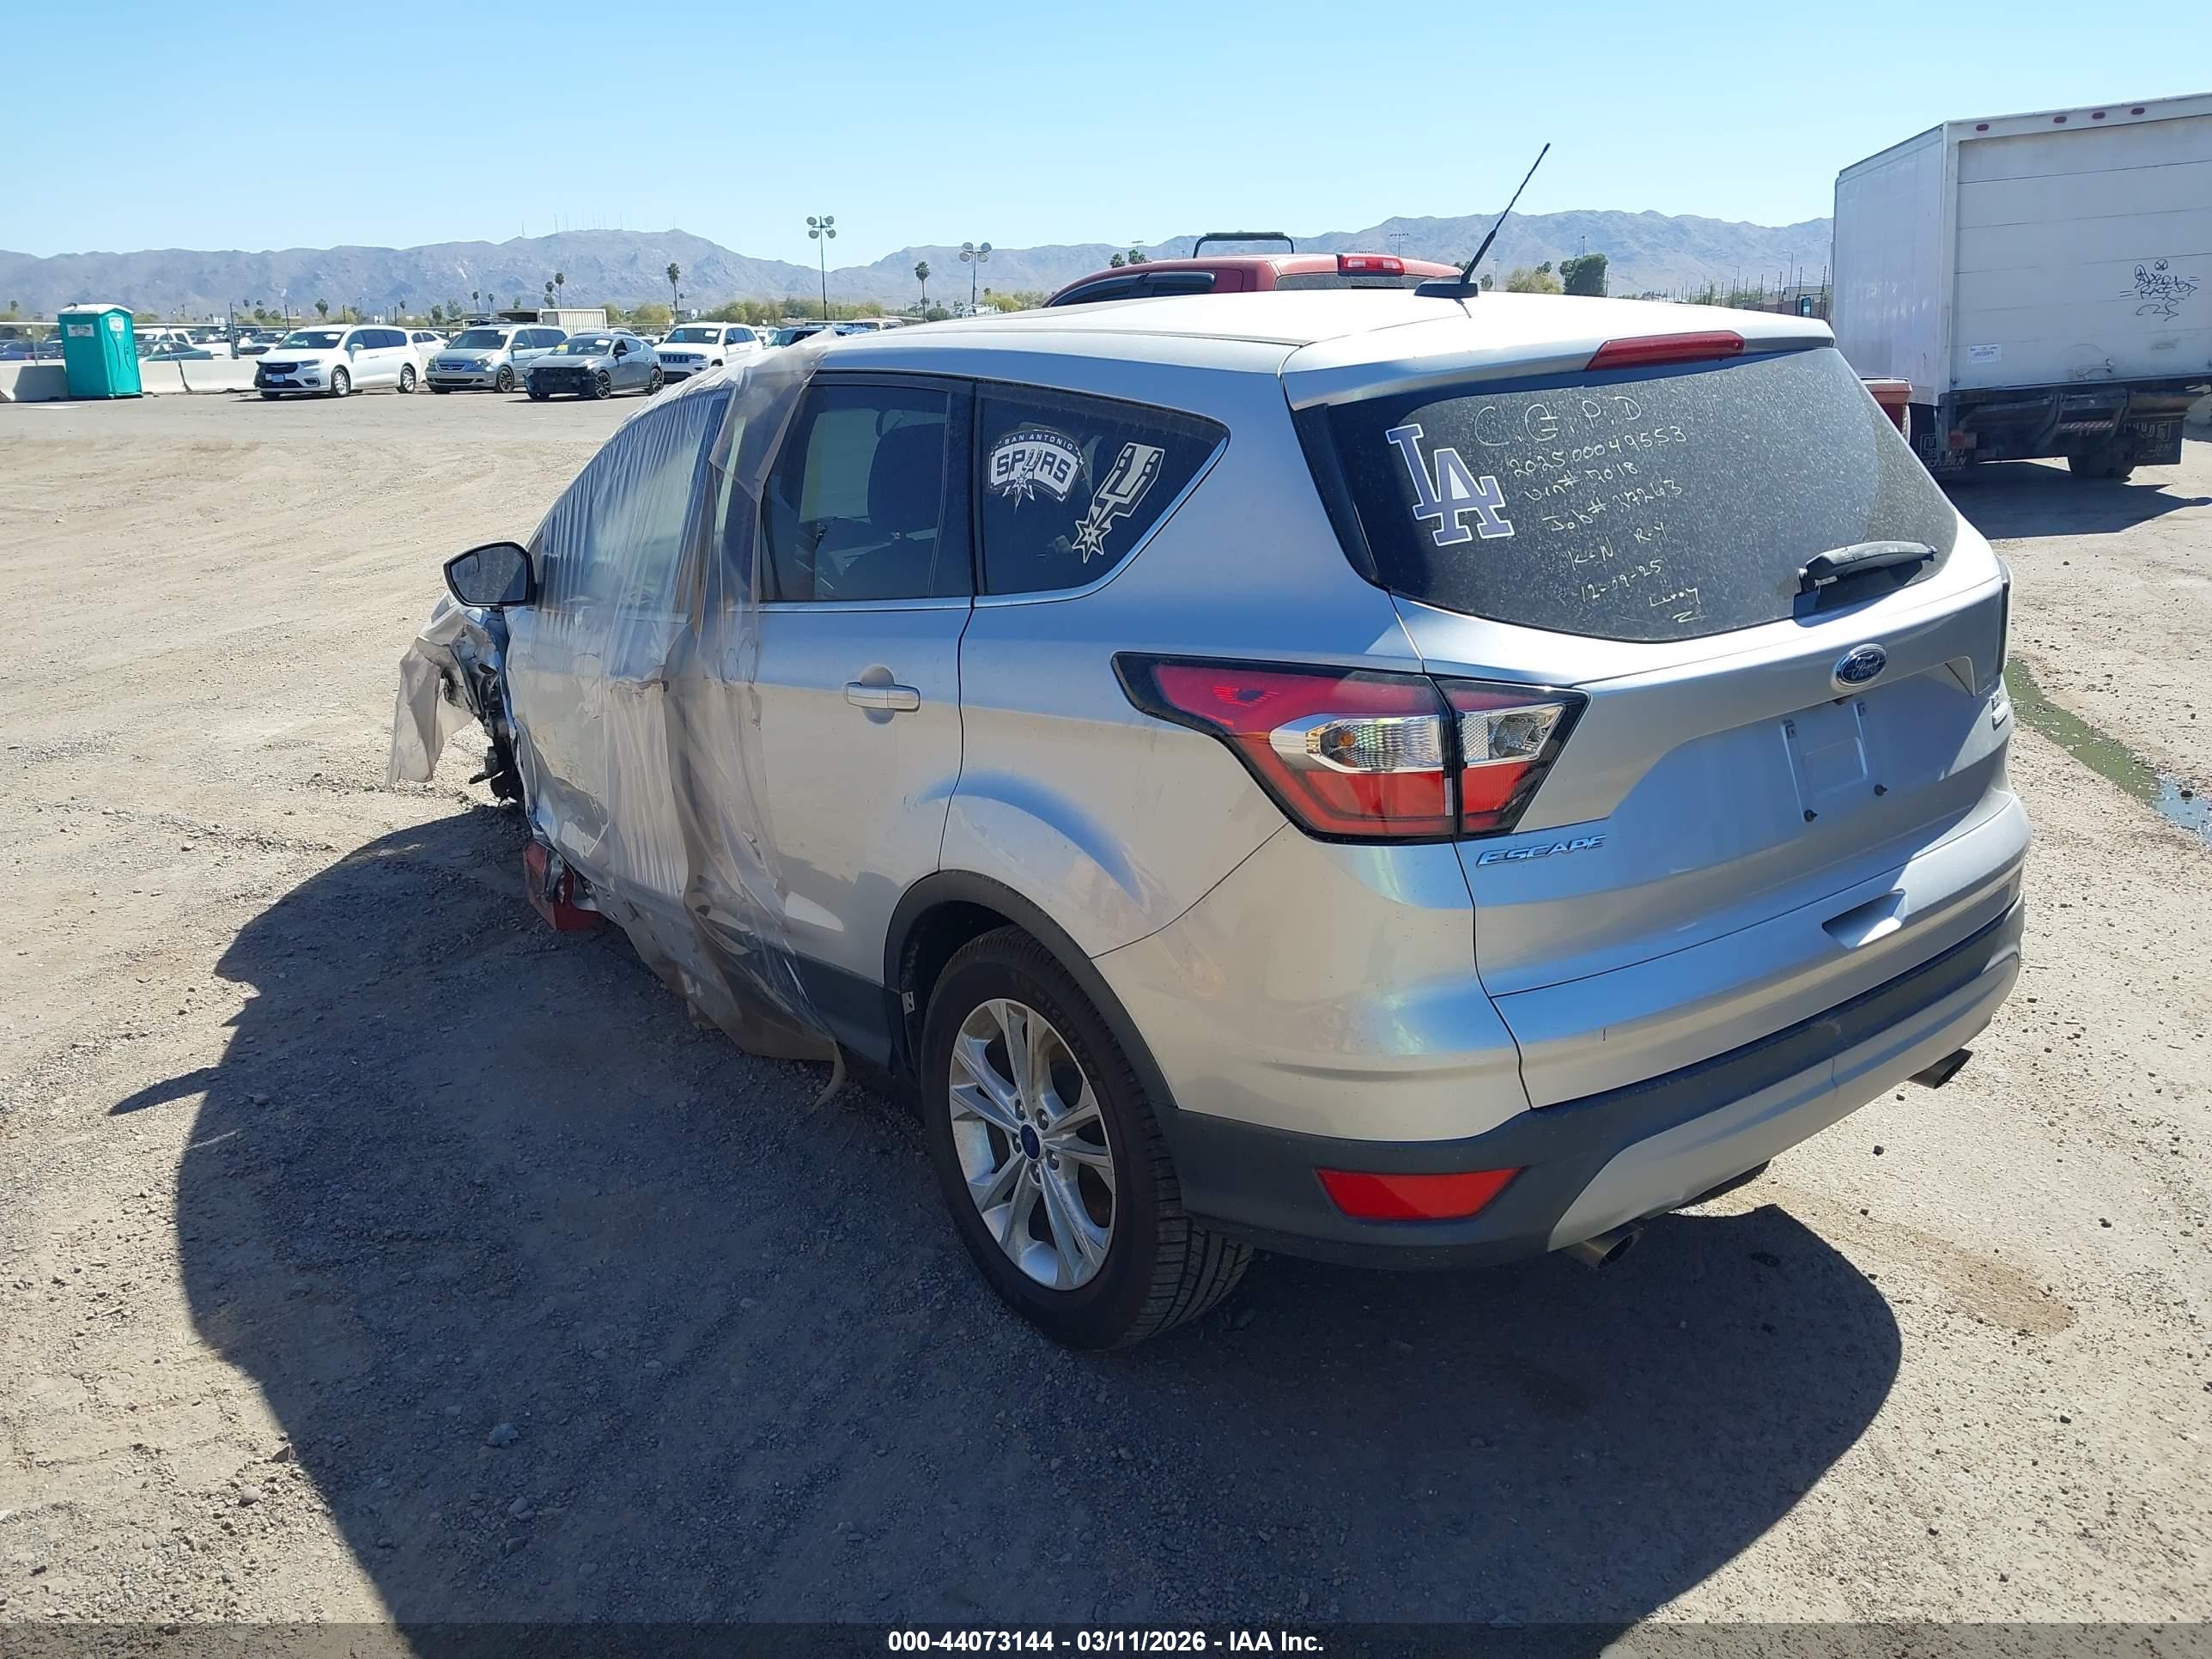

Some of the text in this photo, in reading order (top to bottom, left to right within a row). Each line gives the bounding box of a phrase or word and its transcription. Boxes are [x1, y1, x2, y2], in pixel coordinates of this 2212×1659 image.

[1004, 433, 1073, 451] SAN ANTONIO
[1385, 423, 1515, 546] LA
[1850, 655, 1886, 680] Ford
[1476, 834, 1608, 867] ESCAPE
